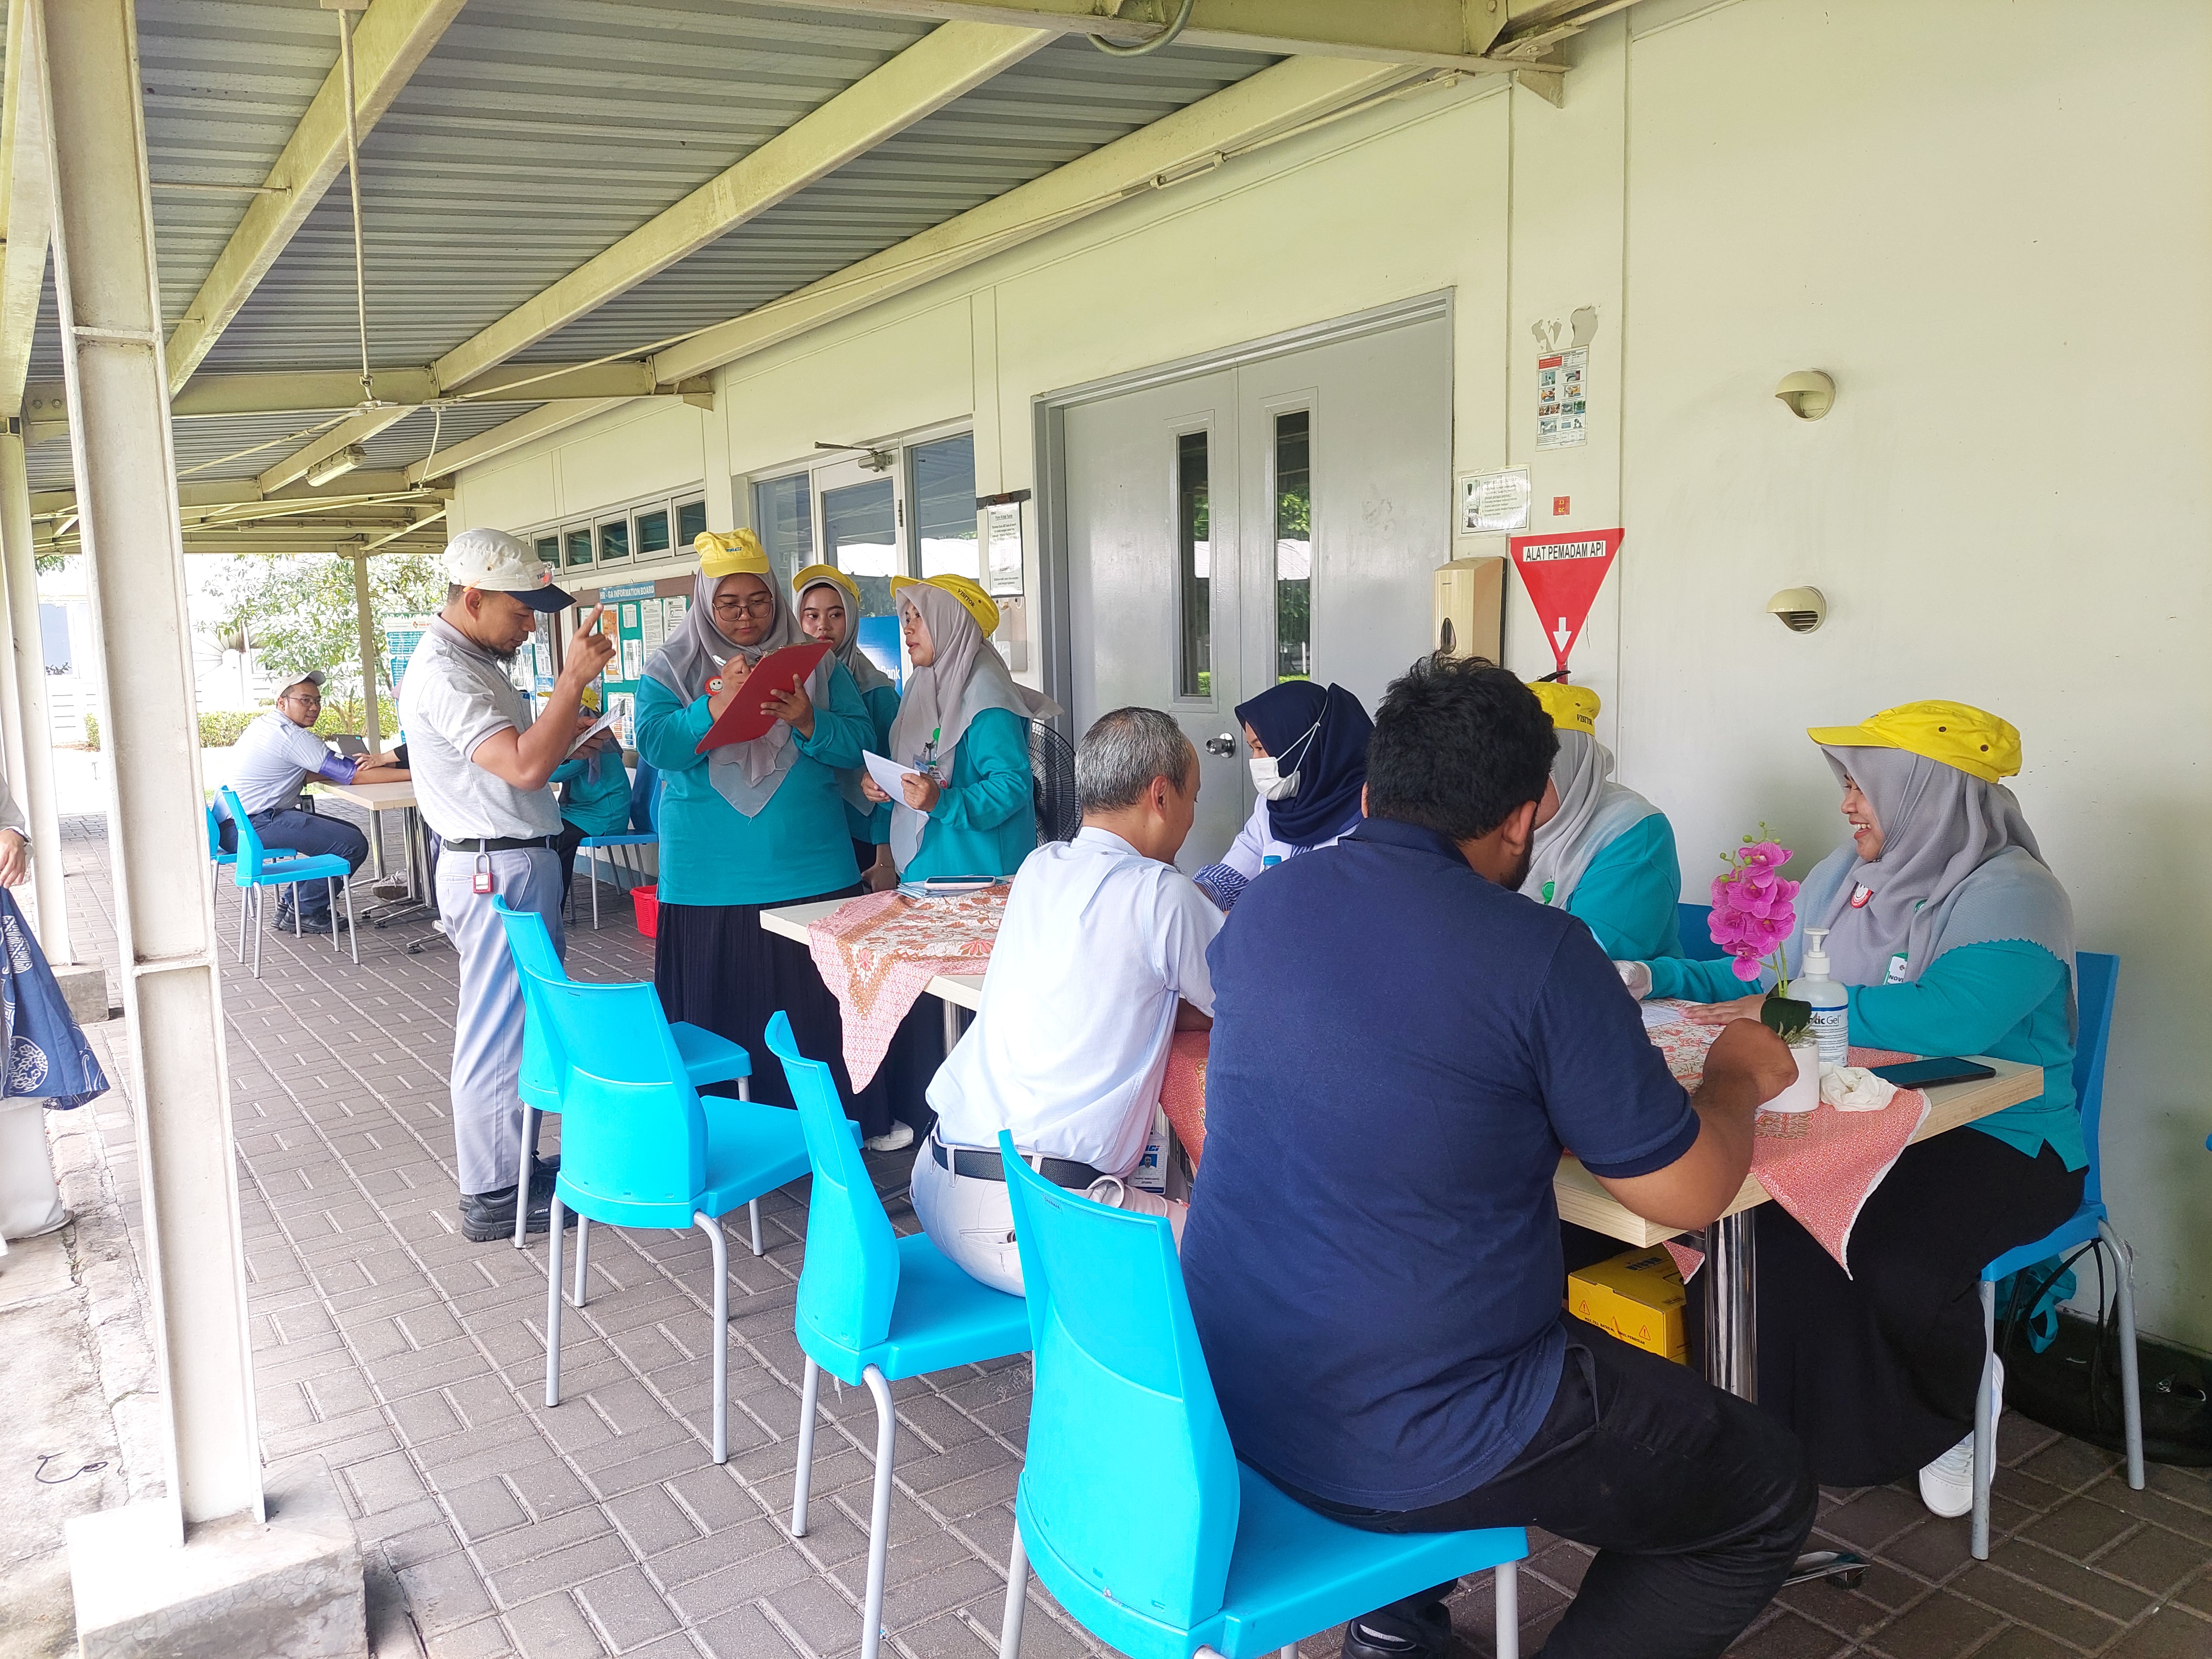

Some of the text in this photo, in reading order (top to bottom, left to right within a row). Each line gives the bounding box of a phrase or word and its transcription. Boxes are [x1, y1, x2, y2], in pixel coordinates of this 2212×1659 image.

[1526, 542, 1604, 561] ALAT PEMADAM API
[600, 591, 606, 599] HR
[608, 590, 614, 598] GA
[614, 587, 640, 597] INFORMATION
[640, 585, 654, 595] BOARD
[958, 588, 975, 608] VISITOR
[1577, 714, 1593, 726] VISITOR
